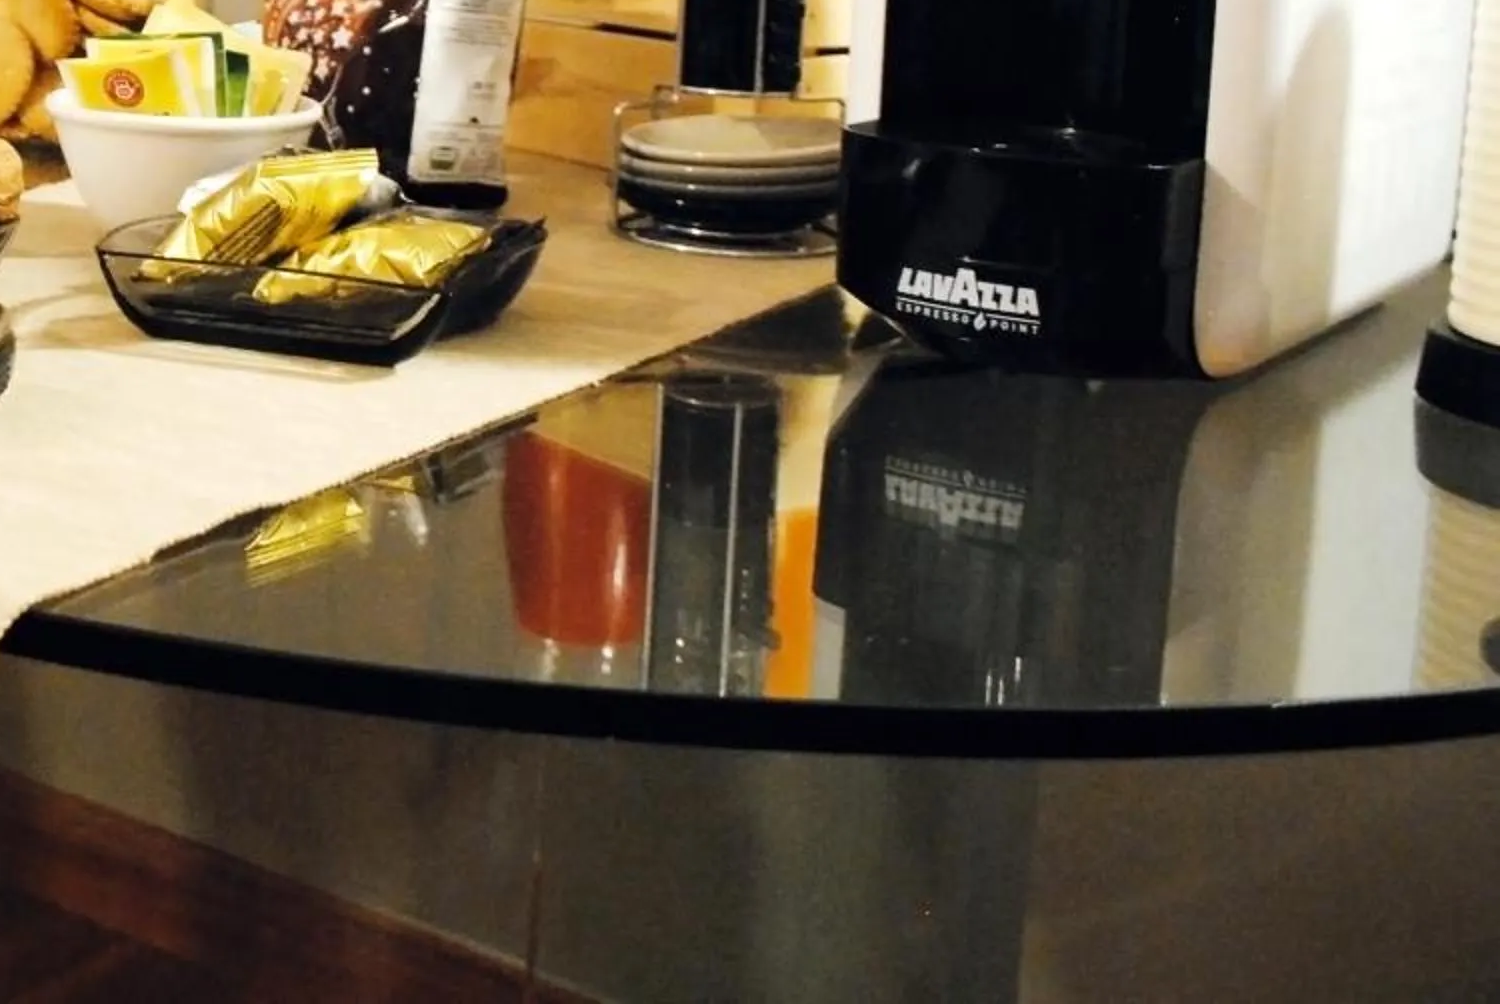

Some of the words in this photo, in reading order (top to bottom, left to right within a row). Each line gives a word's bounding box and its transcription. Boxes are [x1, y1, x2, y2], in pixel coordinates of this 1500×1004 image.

[897, 267, 1040, 317] LAVAZZA
[896, 301, 970, 325] ESPRESSO
[989, 319, 1039, 336] POINT
